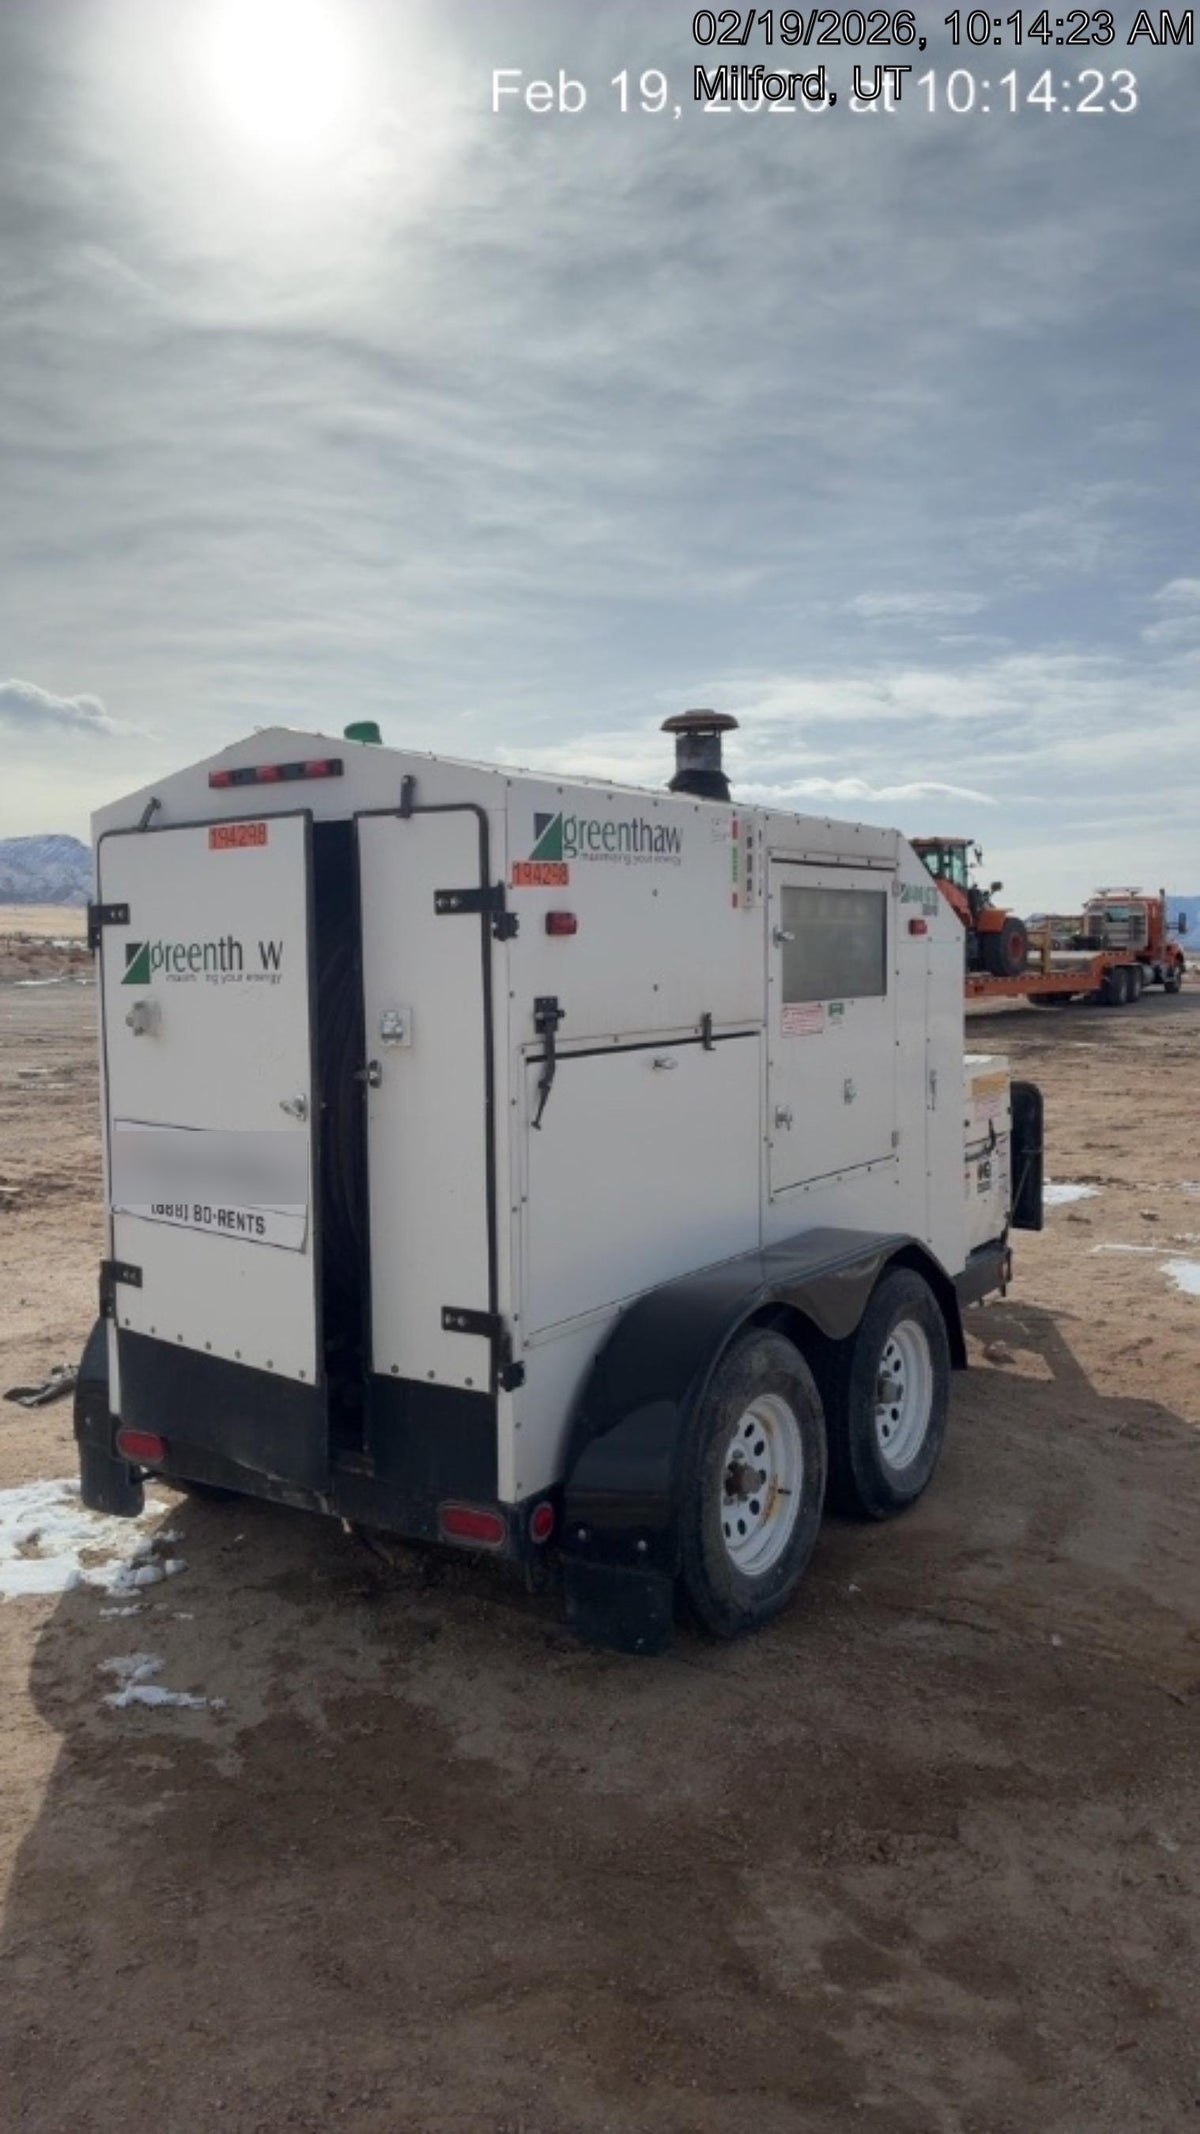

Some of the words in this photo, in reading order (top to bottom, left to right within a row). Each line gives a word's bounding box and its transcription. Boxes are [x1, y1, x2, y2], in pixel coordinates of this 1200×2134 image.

[211, 823, 267, 848] 194298
[564, 814, 683, 859] greenthaw
[513, 862, 568, 885] 194298
